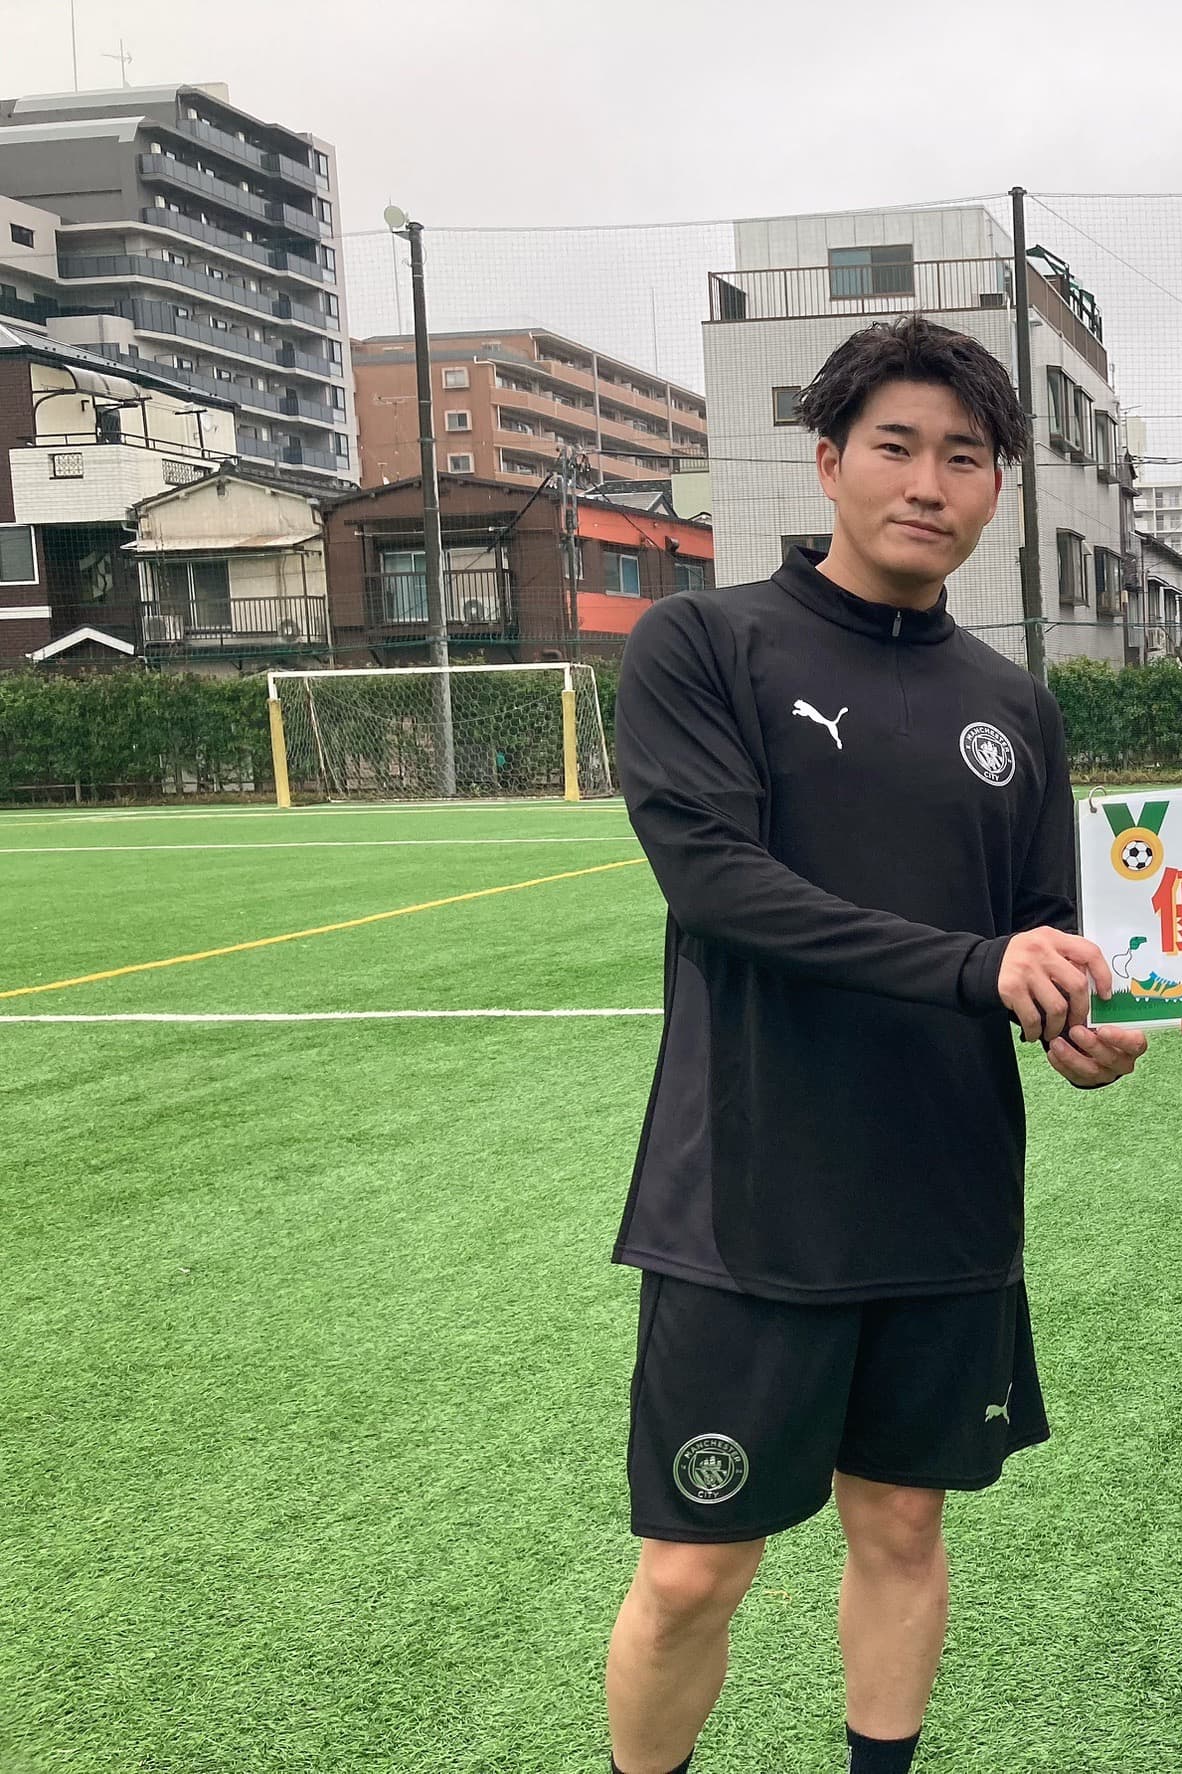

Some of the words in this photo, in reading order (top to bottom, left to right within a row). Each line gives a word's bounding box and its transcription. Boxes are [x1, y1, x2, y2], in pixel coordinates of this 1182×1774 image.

[966, 727, 1010, 753] MANCHESTER
[983, 771, 1000, 781] CITY
[684, 1440, 742, 1463] MANCHESTER
[697, 1490, 720, 1499] CITY
